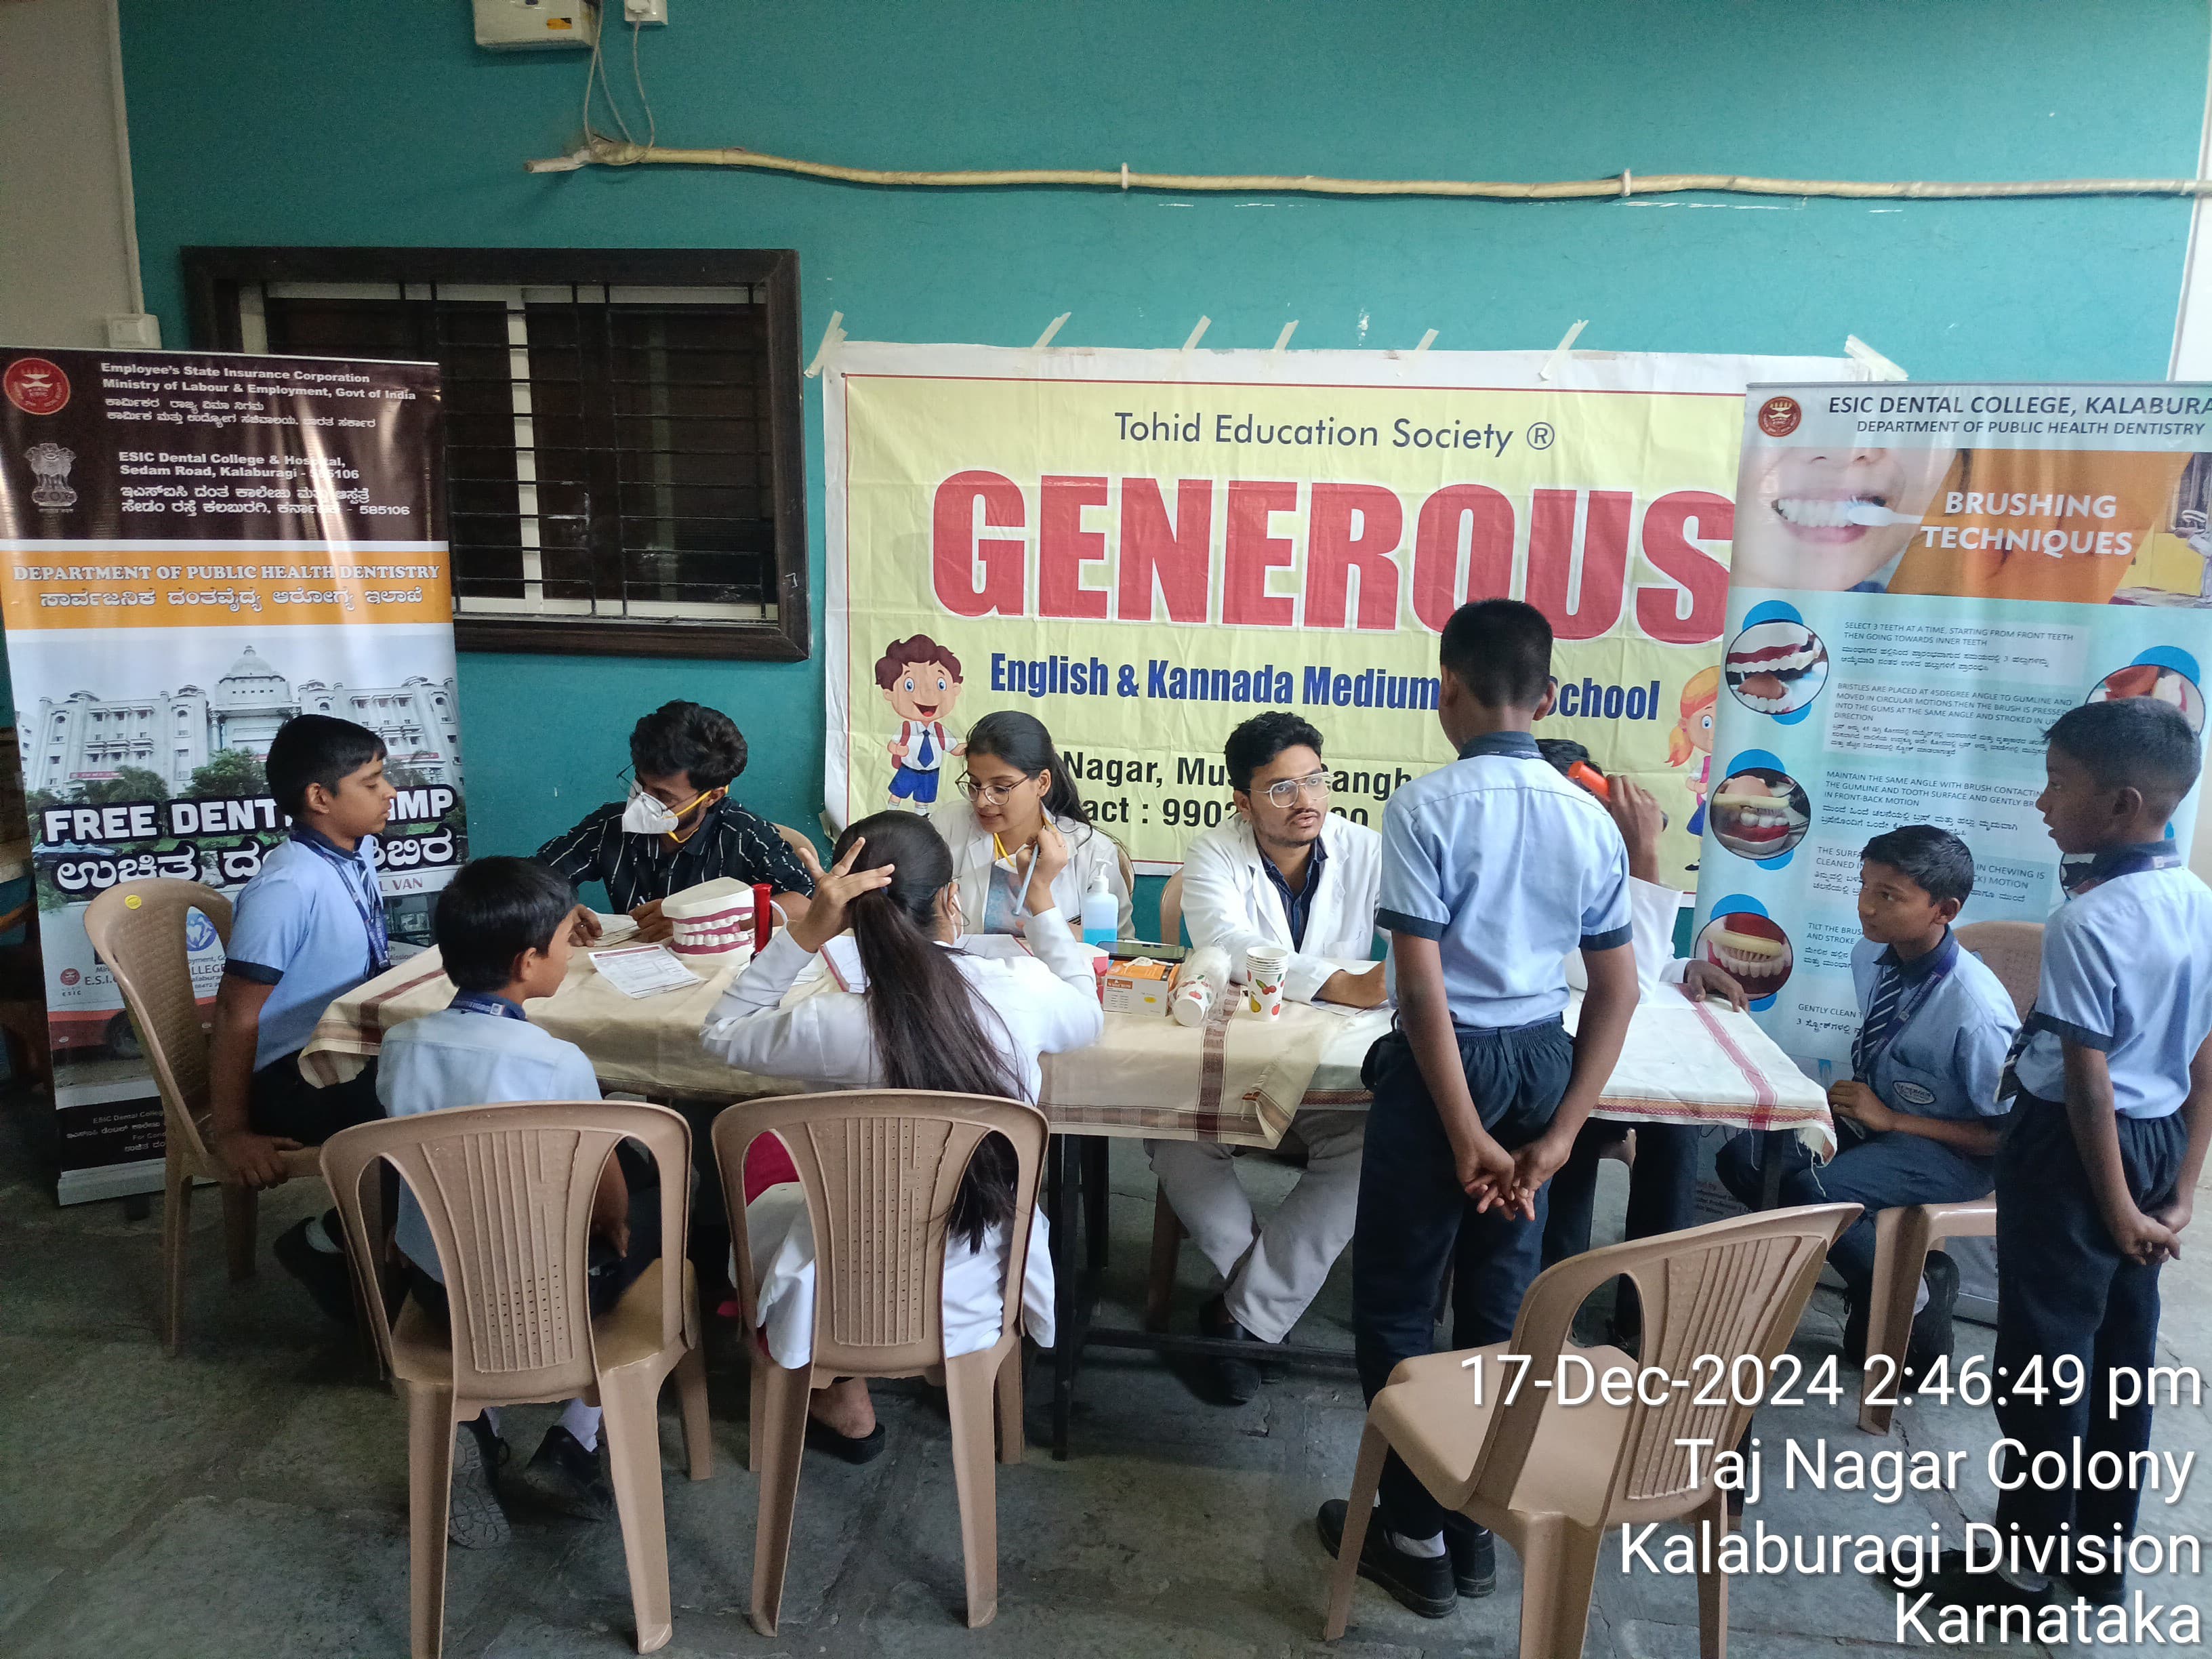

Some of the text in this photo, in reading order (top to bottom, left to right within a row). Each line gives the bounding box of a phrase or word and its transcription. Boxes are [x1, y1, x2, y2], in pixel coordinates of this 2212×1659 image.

[101, 363, 369, 382] Employee's State Insurance Corporation
[103, 379, 415, 399] Ministry of Labour & Employment, Govt of India
[1829, 396, 1874, 413] ESIC
[1880, 396, 1964, 413] DENTAL
[1971, 396, 2076, 417] COLLEGE,
[157, 411, 183, 424] ಮತ್ತು
[1115, 411, 1513, 457] Tohid Education Society
[1857, 421, 2205, 435] DEPARTMENT OF PUBLIC HEALTH DENTISTRY
[119, 452, 279, 466] ESIC Dental College &
[120, 465, 297, 479] Sedam Road, Kalaburagi
[194, 485, 229, 497] ದಂತ
[122, 499, 165, 512] ಸೇಡಂ
[171, 499, 197, 516] ರಸ್ತೆ
[359, 506, 410, 514] 585106
[1945, 492, 2116, 519] BRUSHING
[1921, 526, 2133, 558] TECHNIQUES
[933, 470, 1735, 644] GENEROUS
[13, 566, 440, 580] DEPARTMENT OF PUBLIC HEALTH DENTISTRY
[40, 586, 422, 612] ಸಾರ್ವಜನಿಕ ದಂತವೈದ್ಯ ಆರೋಗ್ಯ ಇಲಾಖೆ
[1880, 623, 1904, 632] TEETH
[1950, 628, 1988, 636] STARTING
[1894, 635, 1933, 643] TOWARDS
[991, 653, 1108, 698] English
[1117, 663, 1139, 697] &
[1147, 659, 1294, 703] Kannada
[1303, 665, 1440, 710] Medium
[1837, 693, 1864, 701] MOVED
[1877, 696, 1913, 704] CIRCULAR
[1915, 699, 1952, 707] MOTIONS
[1838, 682, 1870, 691] BRISTLES
[1889, 687, 1917, 695] PLACED
[2013, 695, 2051, 704] GUMLINE
[1834, 712, 1873, 721] DIRECTION
[1995, 714, 2032, 723] STROKED
[1063, 752, 1162, 787] Nagar,
[1826, 771, 1866, 781] MAINTAIN
[1885, 777, 1908, 785] SAME
[1910, 779, 1937, 787] ANGLE
[1964, 783, 1992, 792] BRUSH
[1835, 792, 1883, 803] FRONT-BACK
[1885, 797, 1919, 806] MOTION
[1842, 783, 1879, 792] GUMLINE
[1902, 788, 1929, 797] TOOTH
[1931, 791, 1967, 800] SURFACE
[1989, 797, 2021, 806] GENTLY
[45, 798, 293, 842] FREE DENT
[1818, 846, 1833, 855] THE
[1976, 863, 1986, 872] IN
[1988, 865, 2034, 878] CHEWING
[1816, 858, 2028, 889] CLEANED MOTION
[392, 878, 423, 890] VAN
[1809, 922, 1839, 933] TILT THE
[1807, 933, 1855, 945] AND STROKE
[1798, 1003, 1828, 1014] GENTLY
[1830, 1008, 1856, 1018] CLEAN
